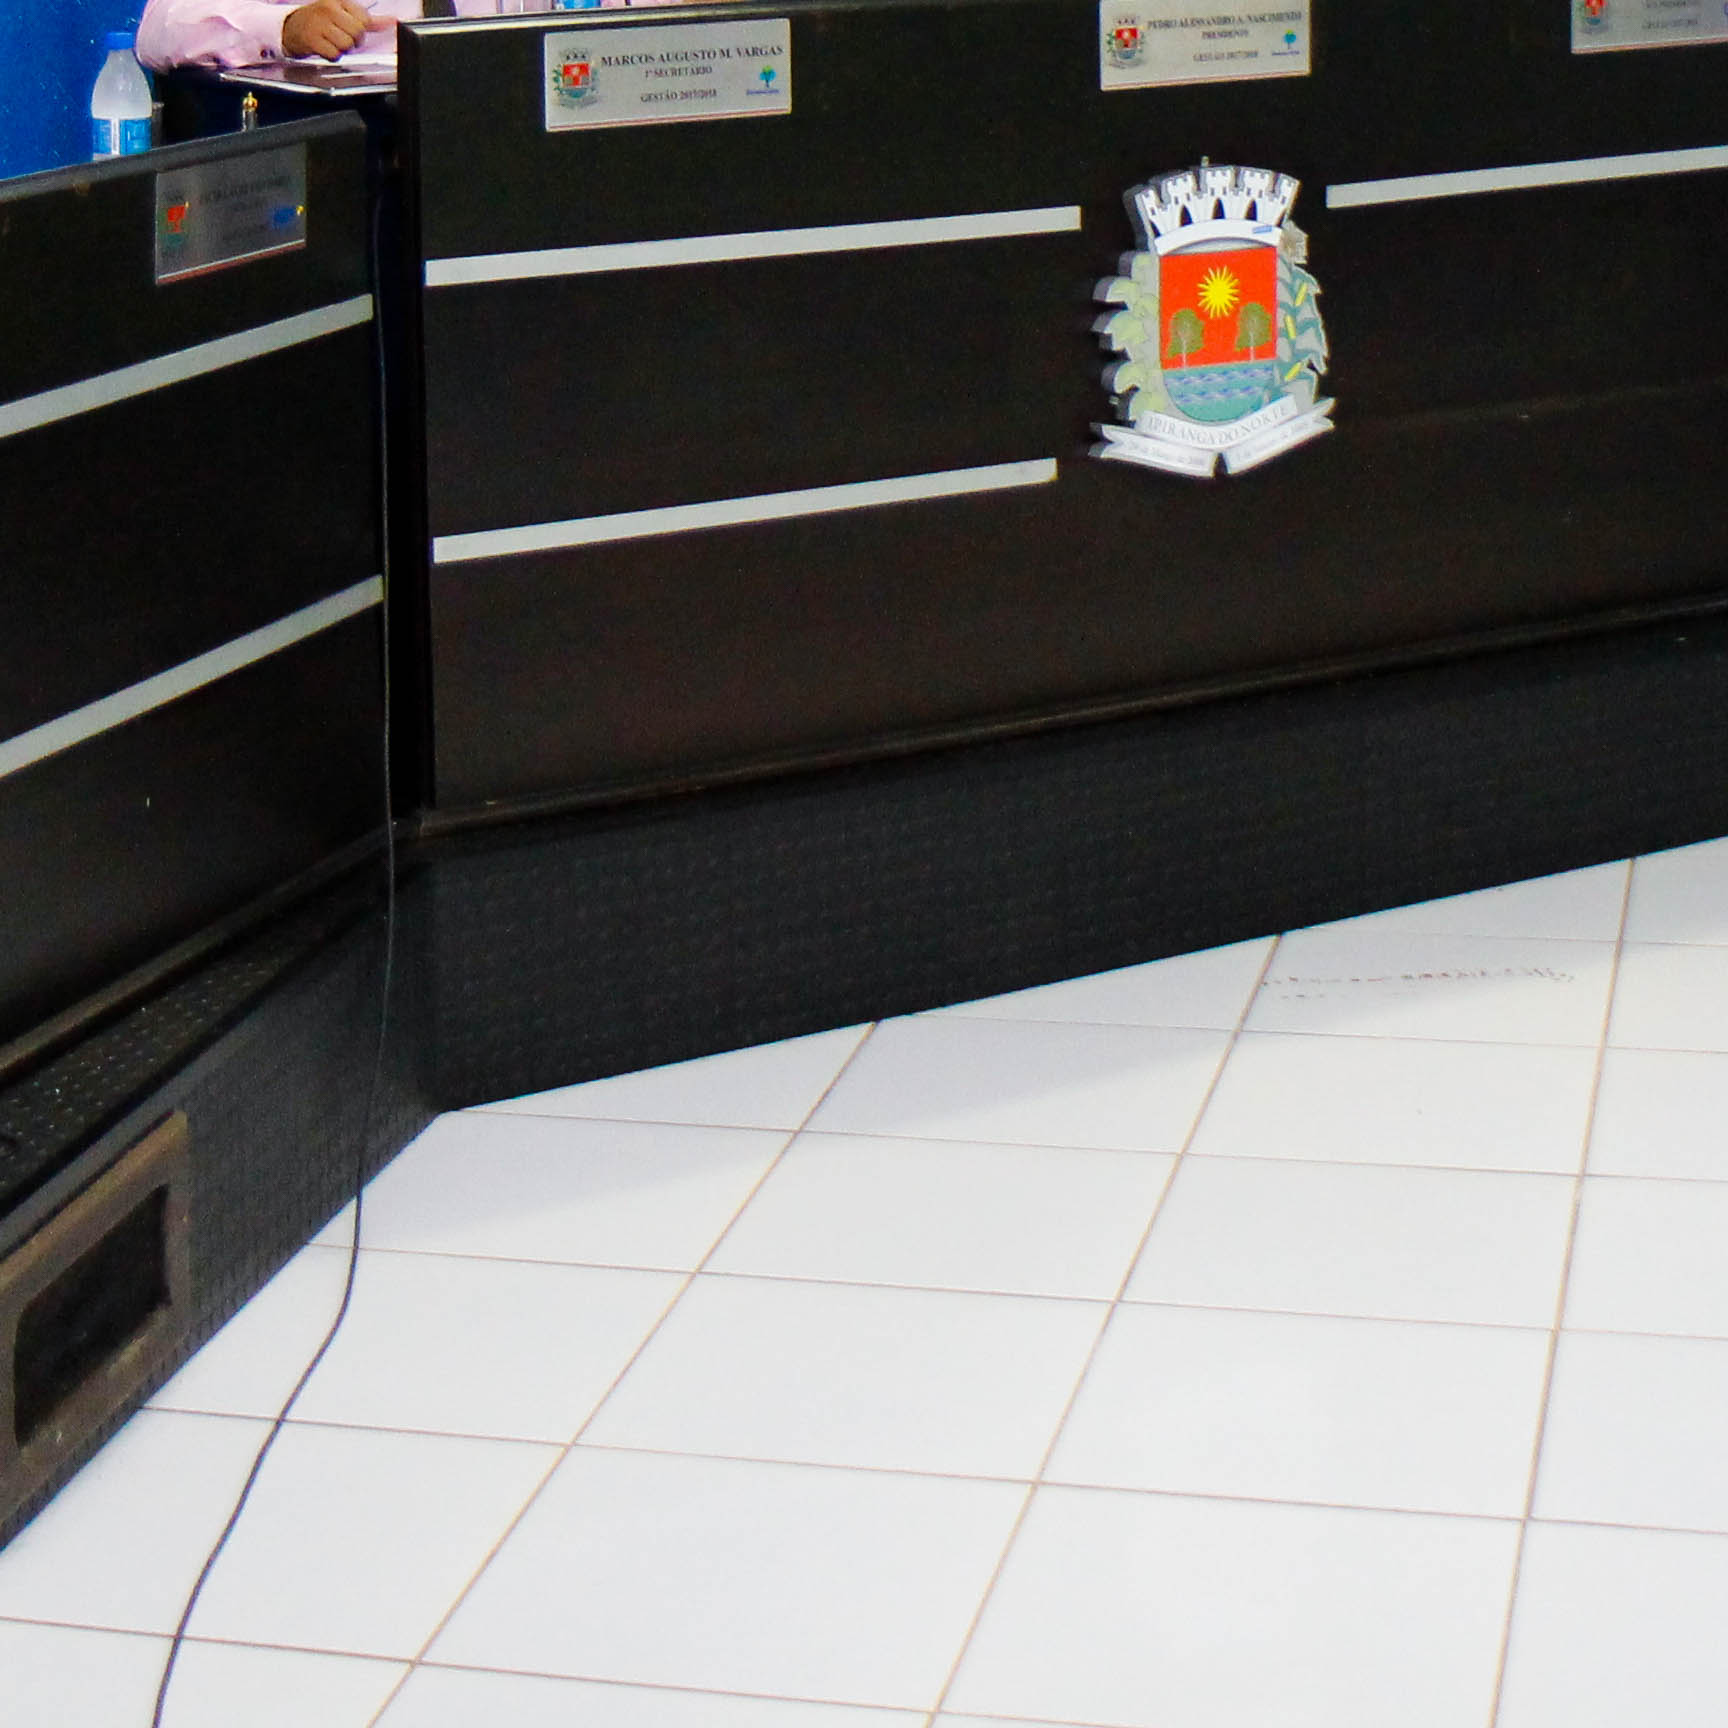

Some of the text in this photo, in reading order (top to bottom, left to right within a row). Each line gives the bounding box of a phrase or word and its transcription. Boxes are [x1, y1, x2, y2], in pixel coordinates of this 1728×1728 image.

[601, 53, 655, 68] MARCOS
[657, 50, 718, 64] AUGUSTO
[734, 45, 784, 57] VARGAS
